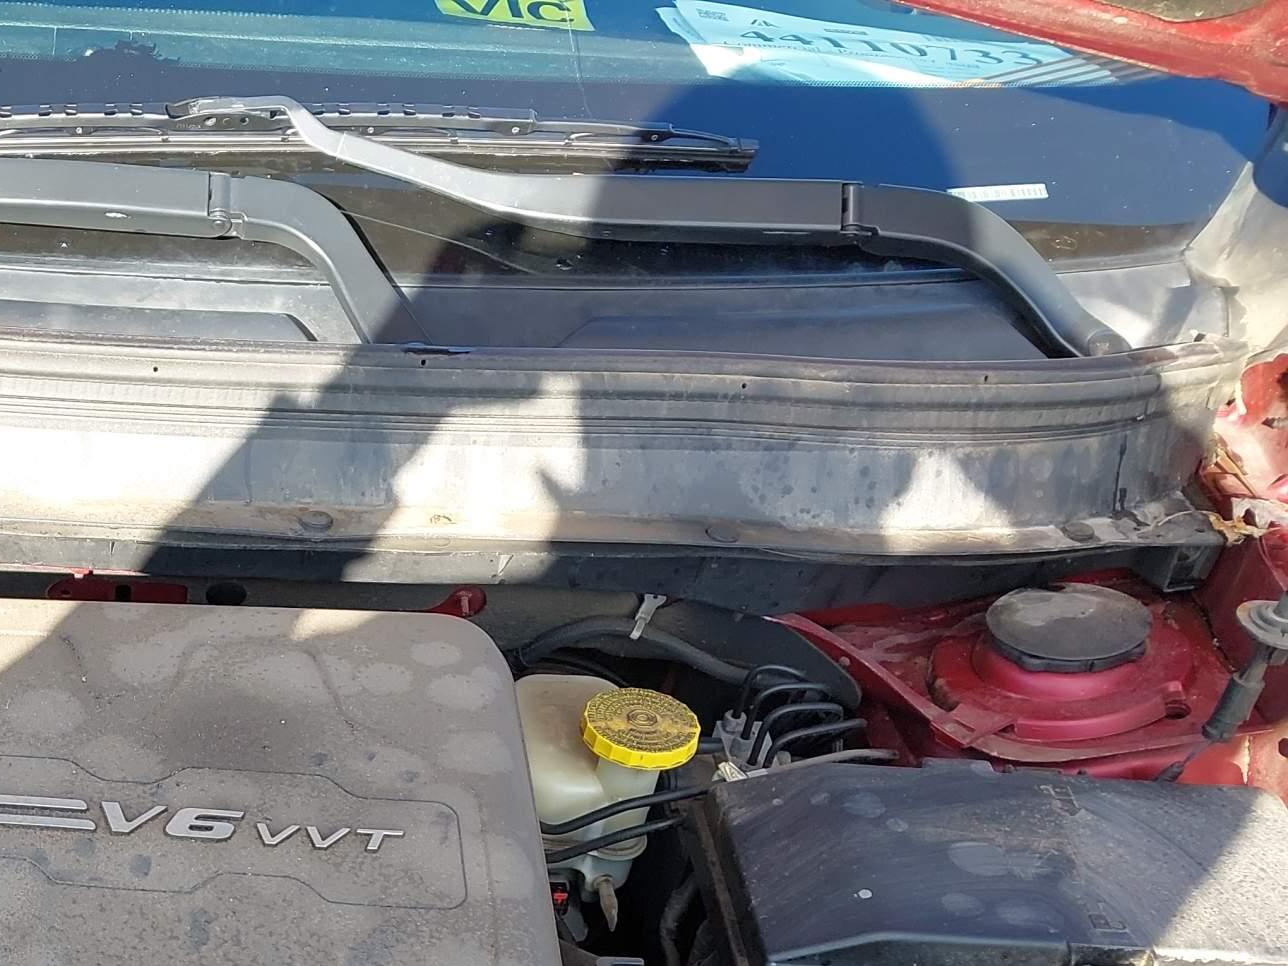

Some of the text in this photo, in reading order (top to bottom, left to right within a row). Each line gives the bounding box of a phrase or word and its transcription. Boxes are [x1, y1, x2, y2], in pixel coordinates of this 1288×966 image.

[740, 30, 1043, 65] 44110733
[100, 801, 406, 852] V6 VVT
